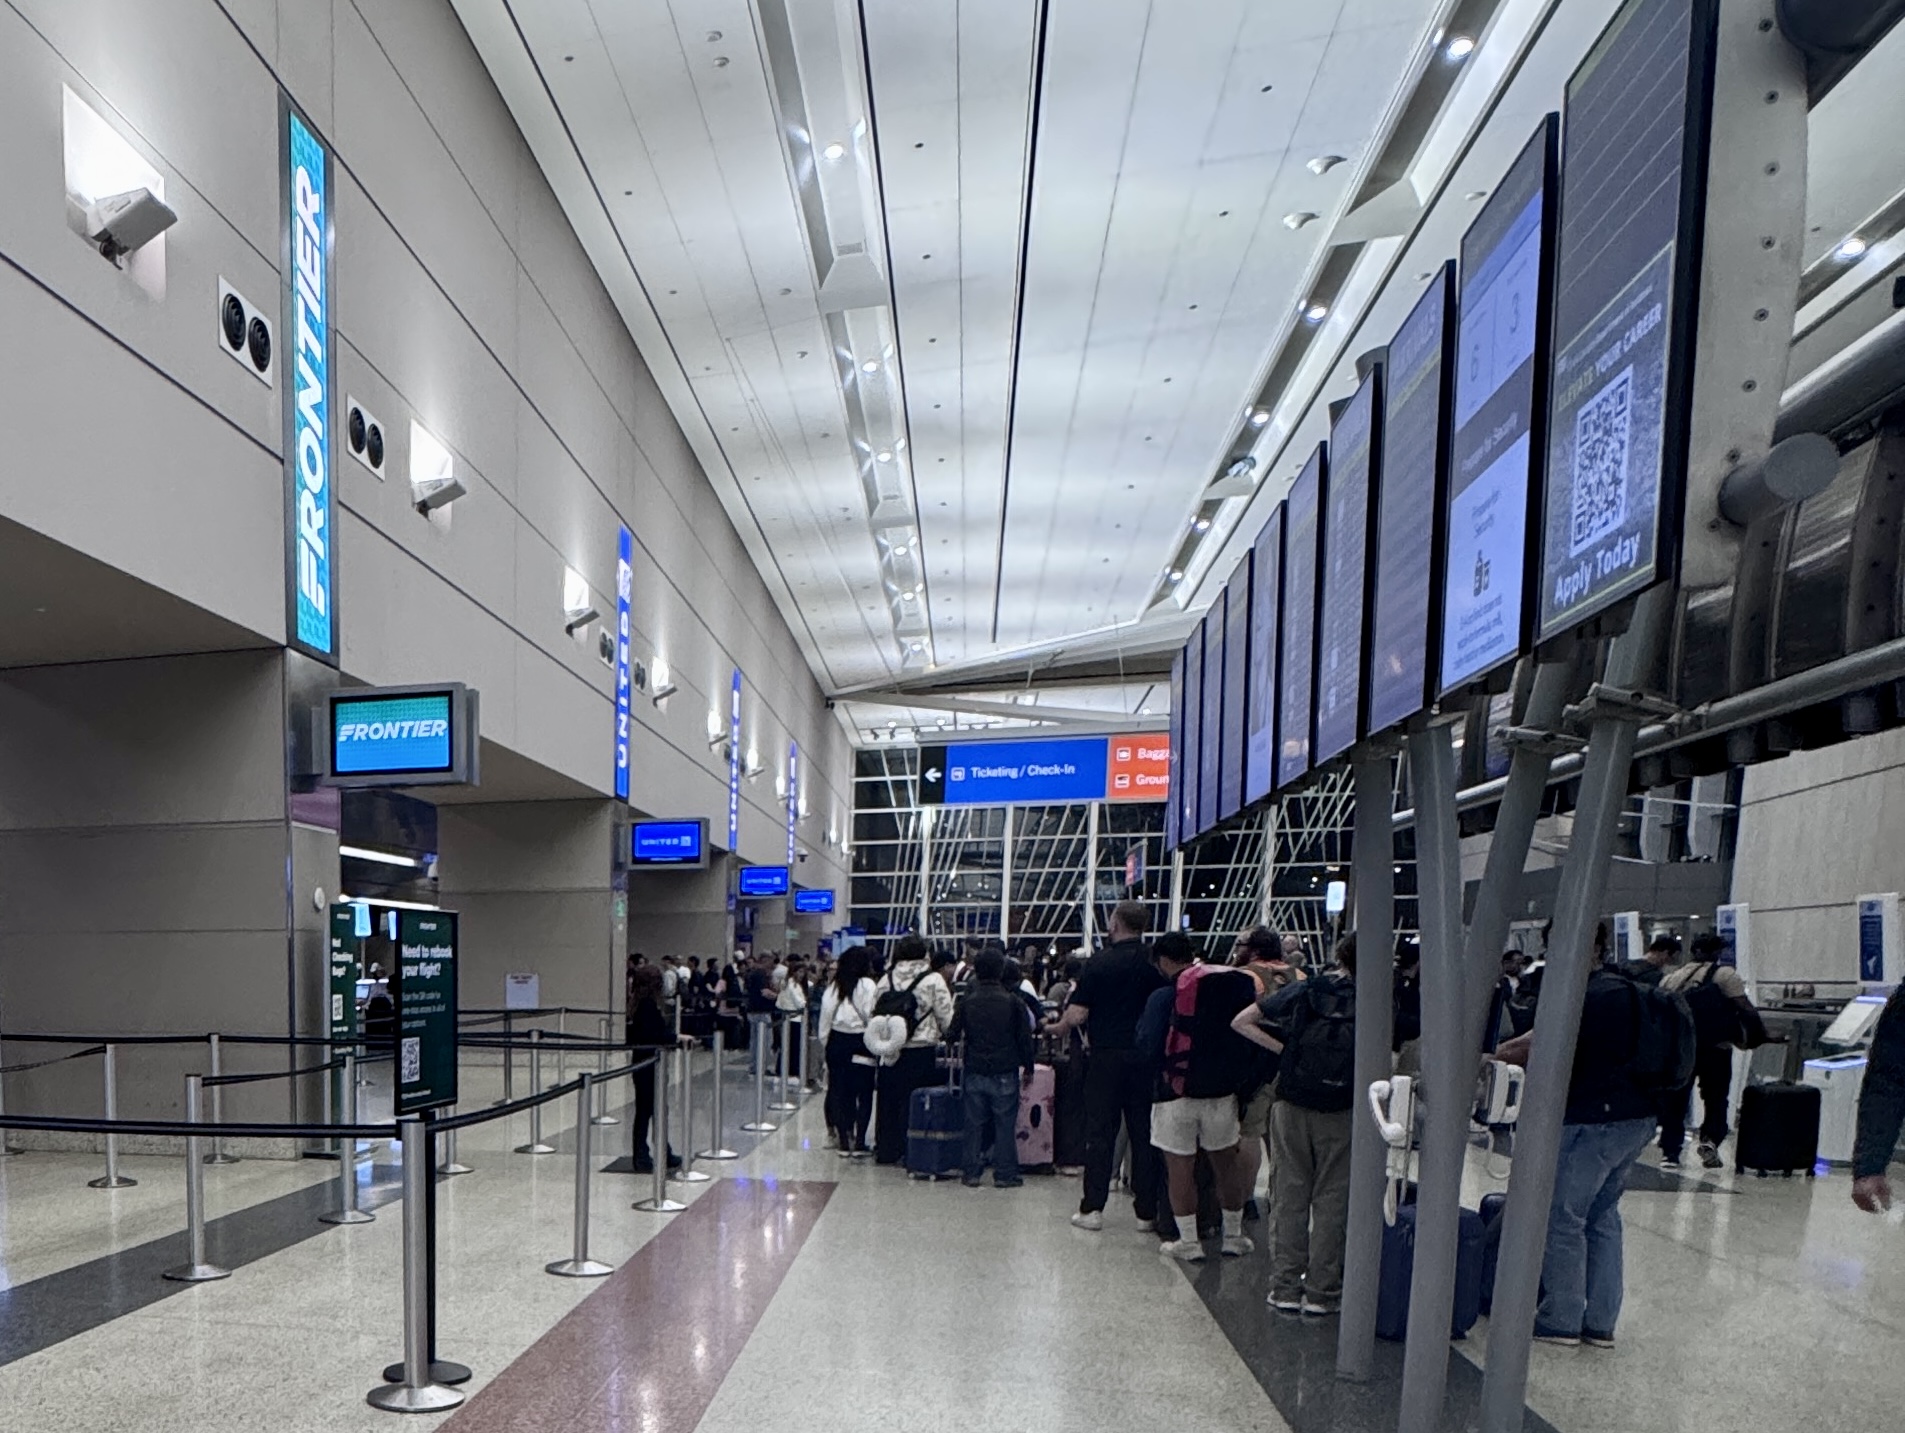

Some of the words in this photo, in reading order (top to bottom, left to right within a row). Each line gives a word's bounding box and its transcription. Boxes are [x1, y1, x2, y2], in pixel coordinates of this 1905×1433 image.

[1595, 340, 1621, 377] YOUR
[1623, 302, 1662, 353] CAREER
[296, 165, 325, 616] FRONTIER
[1554, 560, 1592, 608] Apply
[1596, 531, 1641, 579] Today
[618, 611, 629, 768] UNITED
[338, 720, 448, 742] FRONTIER
[970, 767, 1019, 779] Ticketing
[1020, 764, 1026, 777] /
[1027, 763, 1076, 776] Check-In
[1136, 774, 1170, 785] Groun
[641, 838, 679, 846] UNITED
[402, 944, 421, 958] Need
[402, 965, 418, 979] your
[419, 962, 441, 979] flight?
